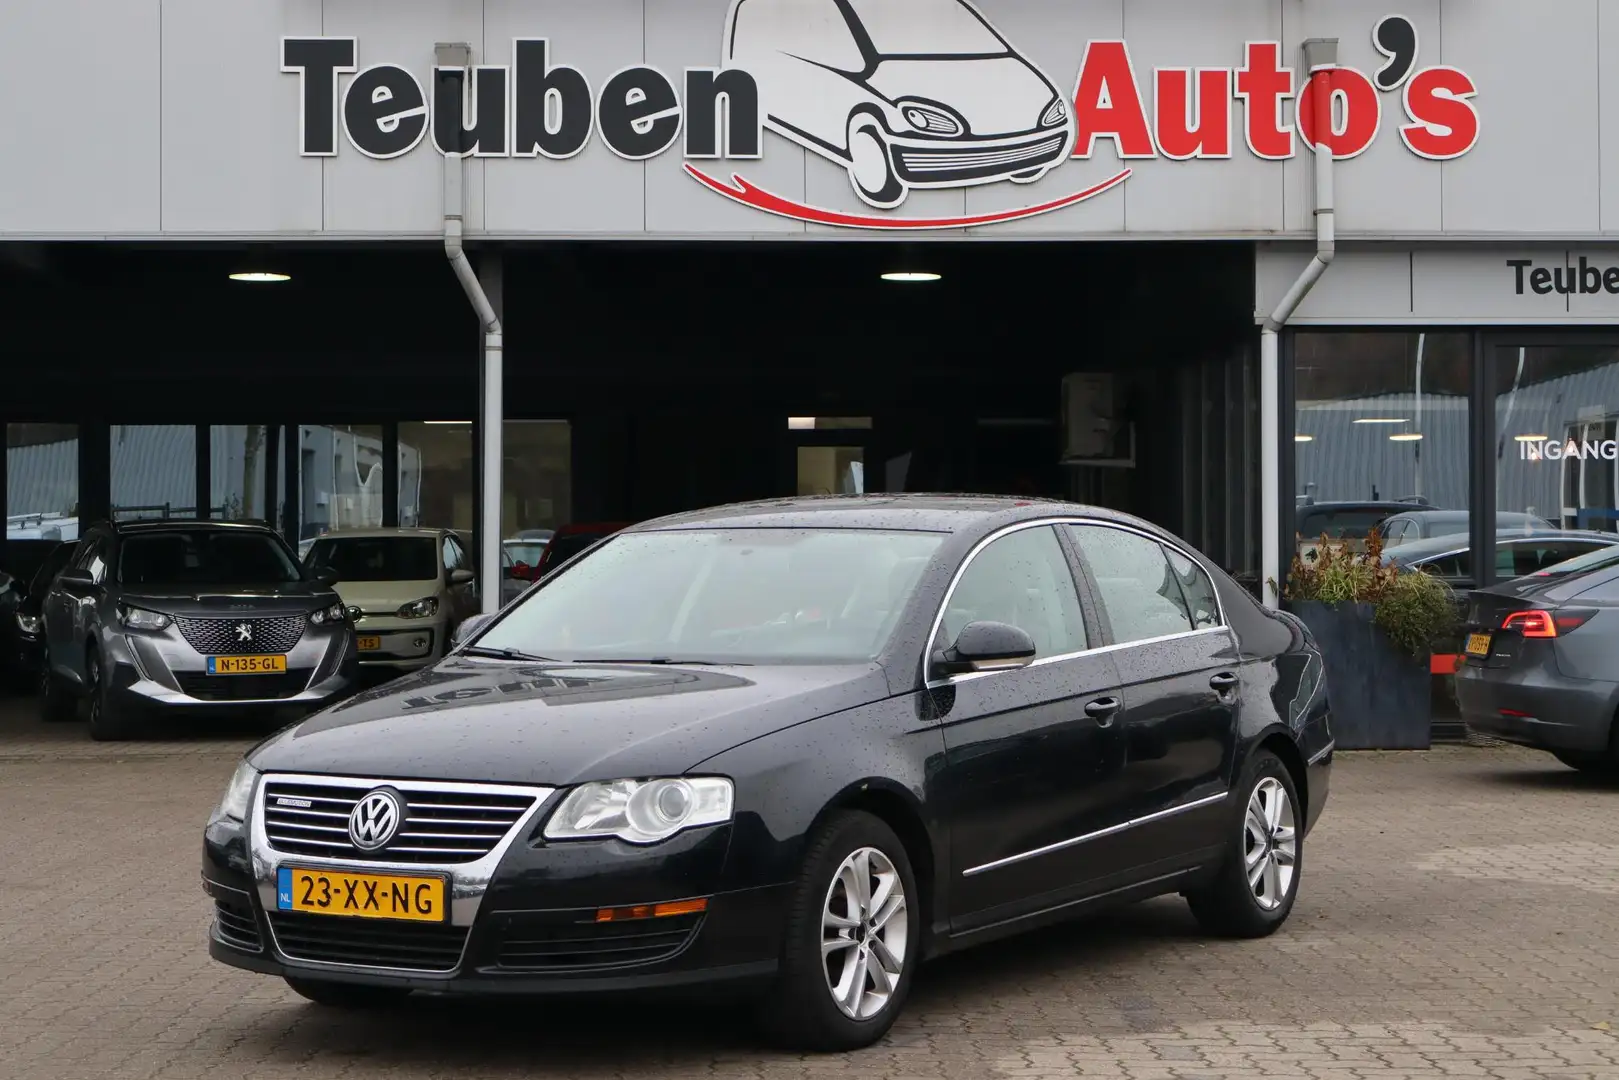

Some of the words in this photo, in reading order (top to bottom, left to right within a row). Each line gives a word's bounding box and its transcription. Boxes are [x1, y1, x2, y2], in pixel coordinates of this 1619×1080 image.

[281, 35, 763, 158] Teuben
[1071, 14, 1480, 160] Auto's
[1506, 256, 1619, 294] Teube
[1520, 440, 1617, 460] INGANG
[221, 658, 279, 671] N-135-GL
[300, 875, 432, 915] 23-XX-NG
